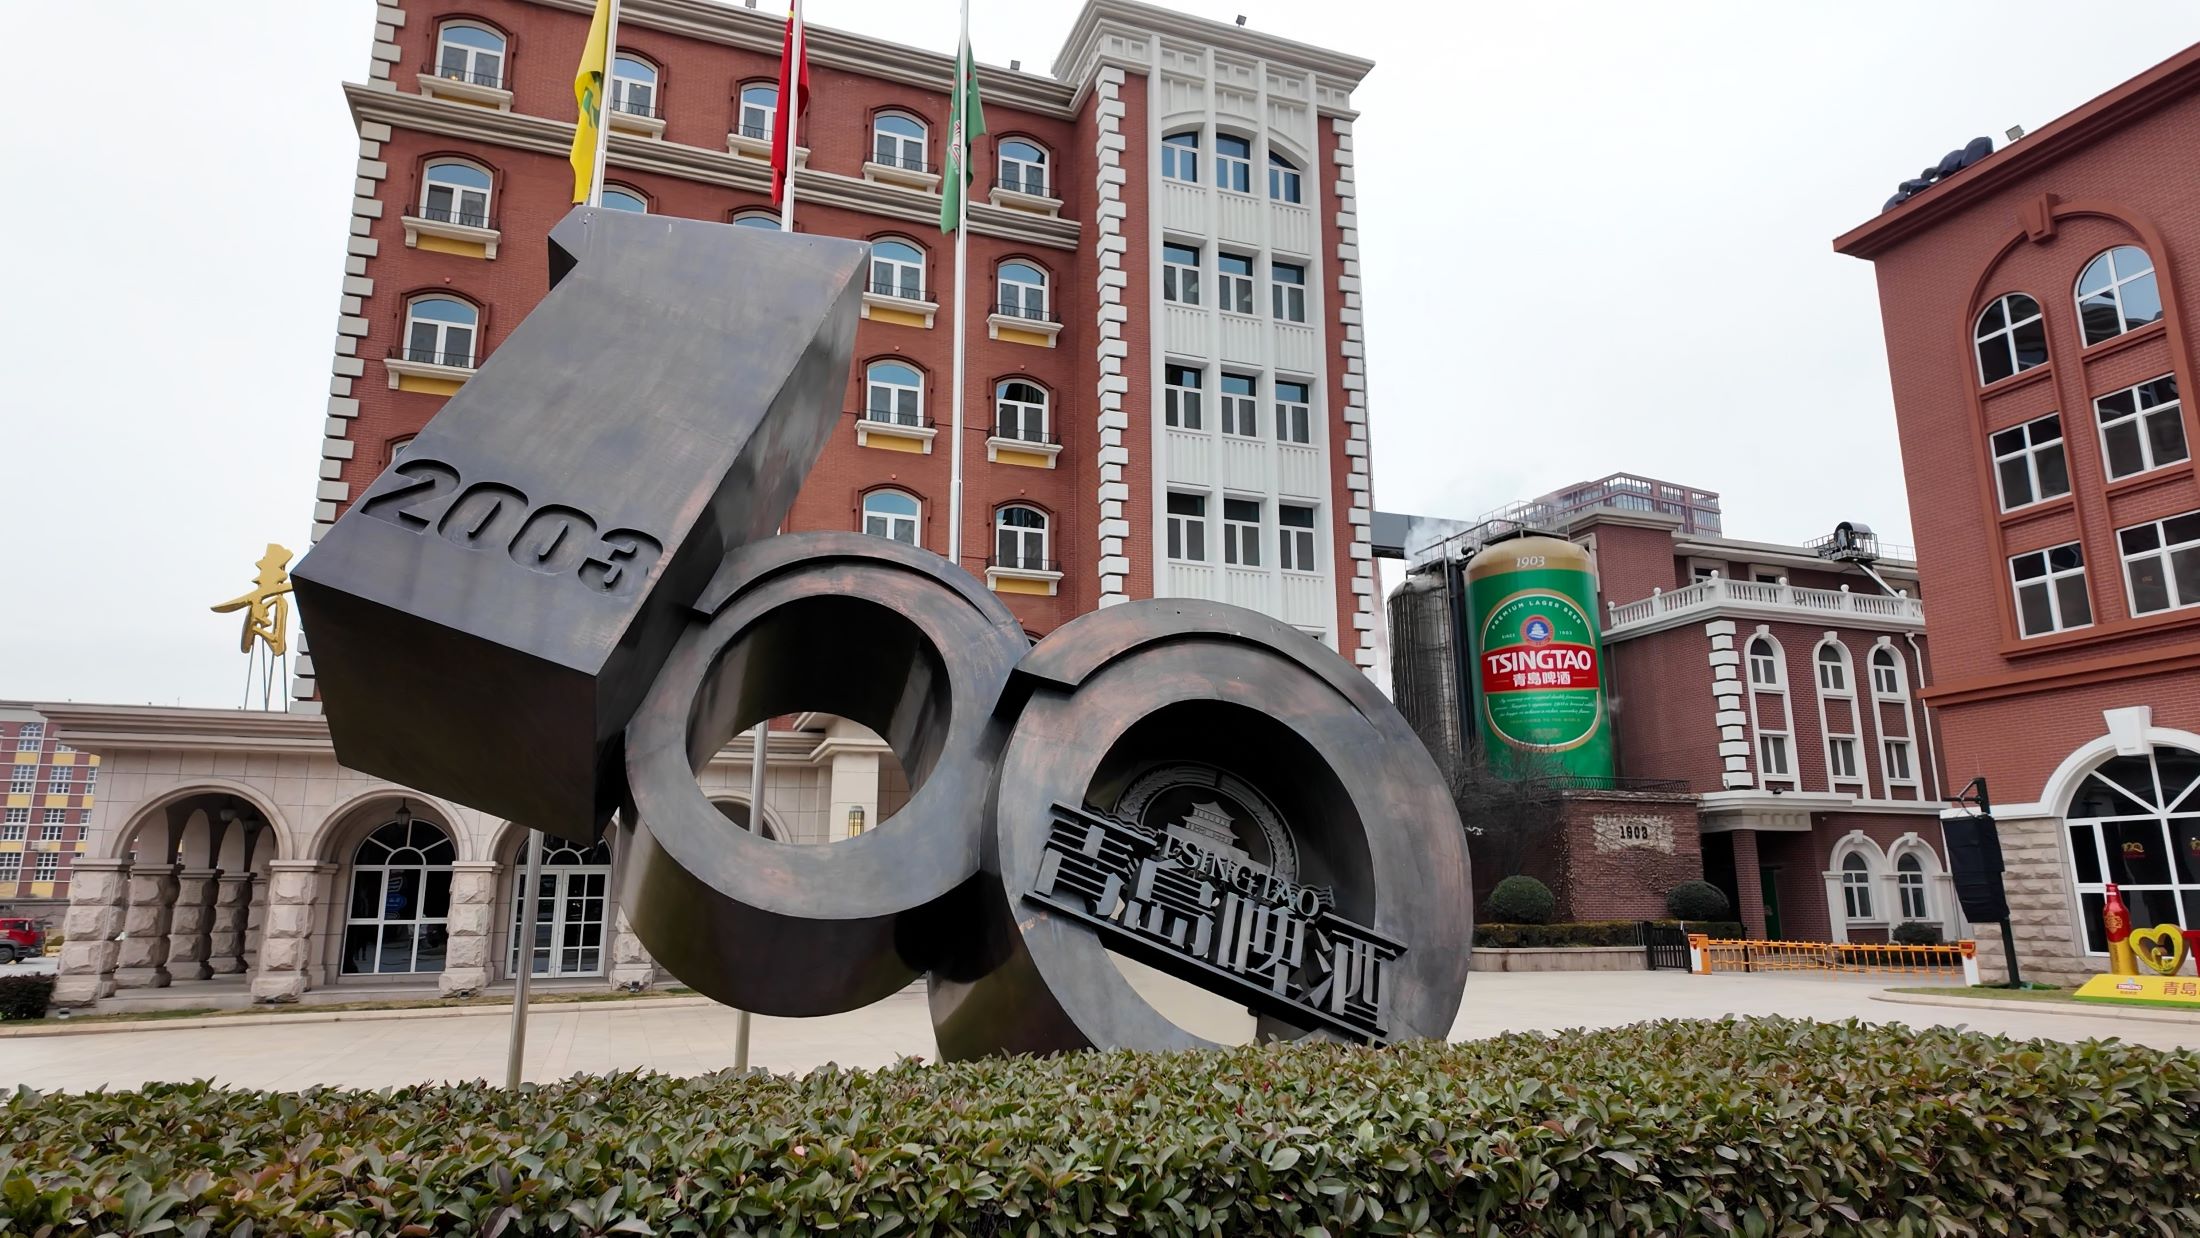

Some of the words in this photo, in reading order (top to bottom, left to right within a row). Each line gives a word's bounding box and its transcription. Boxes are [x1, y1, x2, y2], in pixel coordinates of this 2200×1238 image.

[360, 459, 664, 597] 2003
[1516, 555, 1545, 569] 1903
[210, 543, 293, 657] 青
[1491, 602, 1525, 630] PREMIUM
[1529, 599, 1560, 609] LAGER
[1563, 606, 1582, 625] BEER
[1487, 649, 1592, 675] TSINGTAO
[1513, 671, 1571, 687] 青島啤酒
[1619, 825, 1649, 840] 1903
[1158, 828, 1320, 917] TSINGTAO
